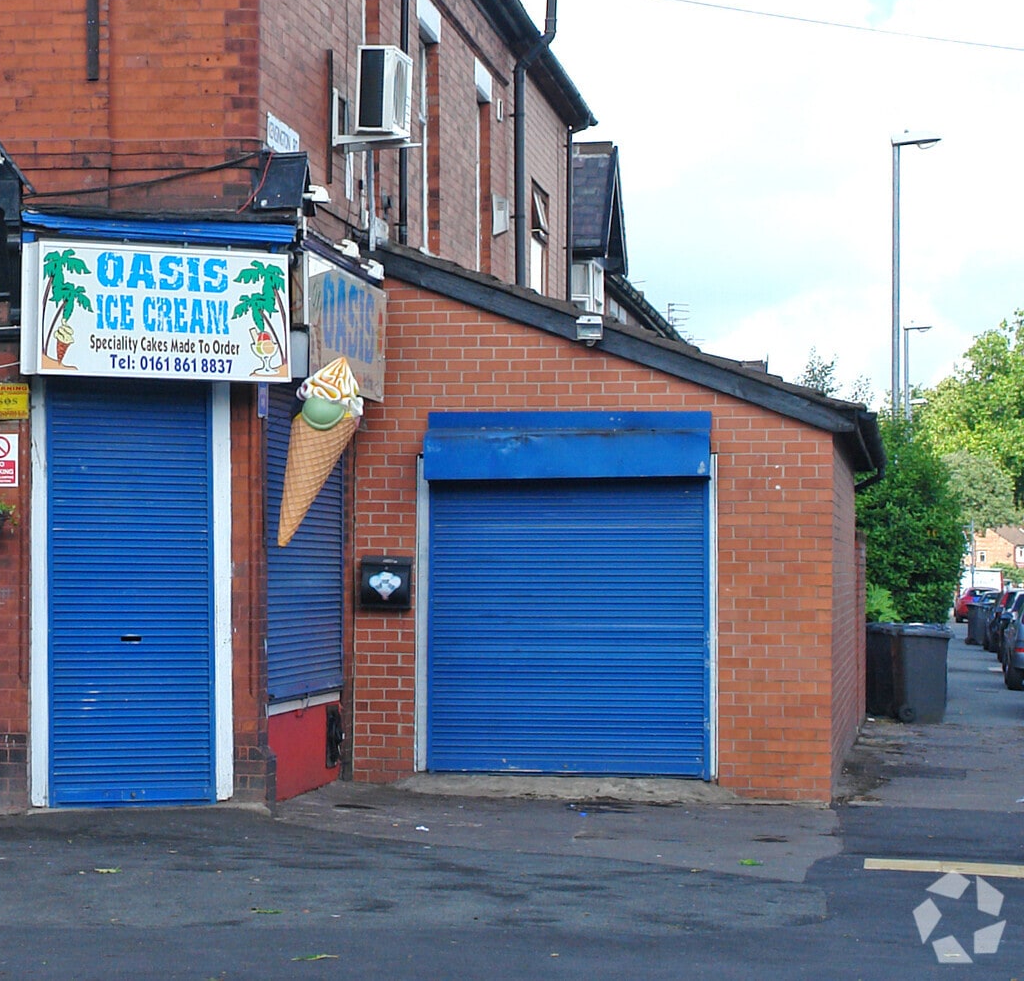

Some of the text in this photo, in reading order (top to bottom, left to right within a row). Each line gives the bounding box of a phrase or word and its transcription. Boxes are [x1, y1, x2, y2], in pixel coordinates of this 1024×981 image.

[97, 251, 229, 294] OASIS
[96, 294, 230, 335] ICE CREAM
[323, 272, 375, 365] OASIS
[90, 334, 240, 355] Speciality Cakes Made To Order
[110, 354, 233, 374] Tel: 0161 861 8837
